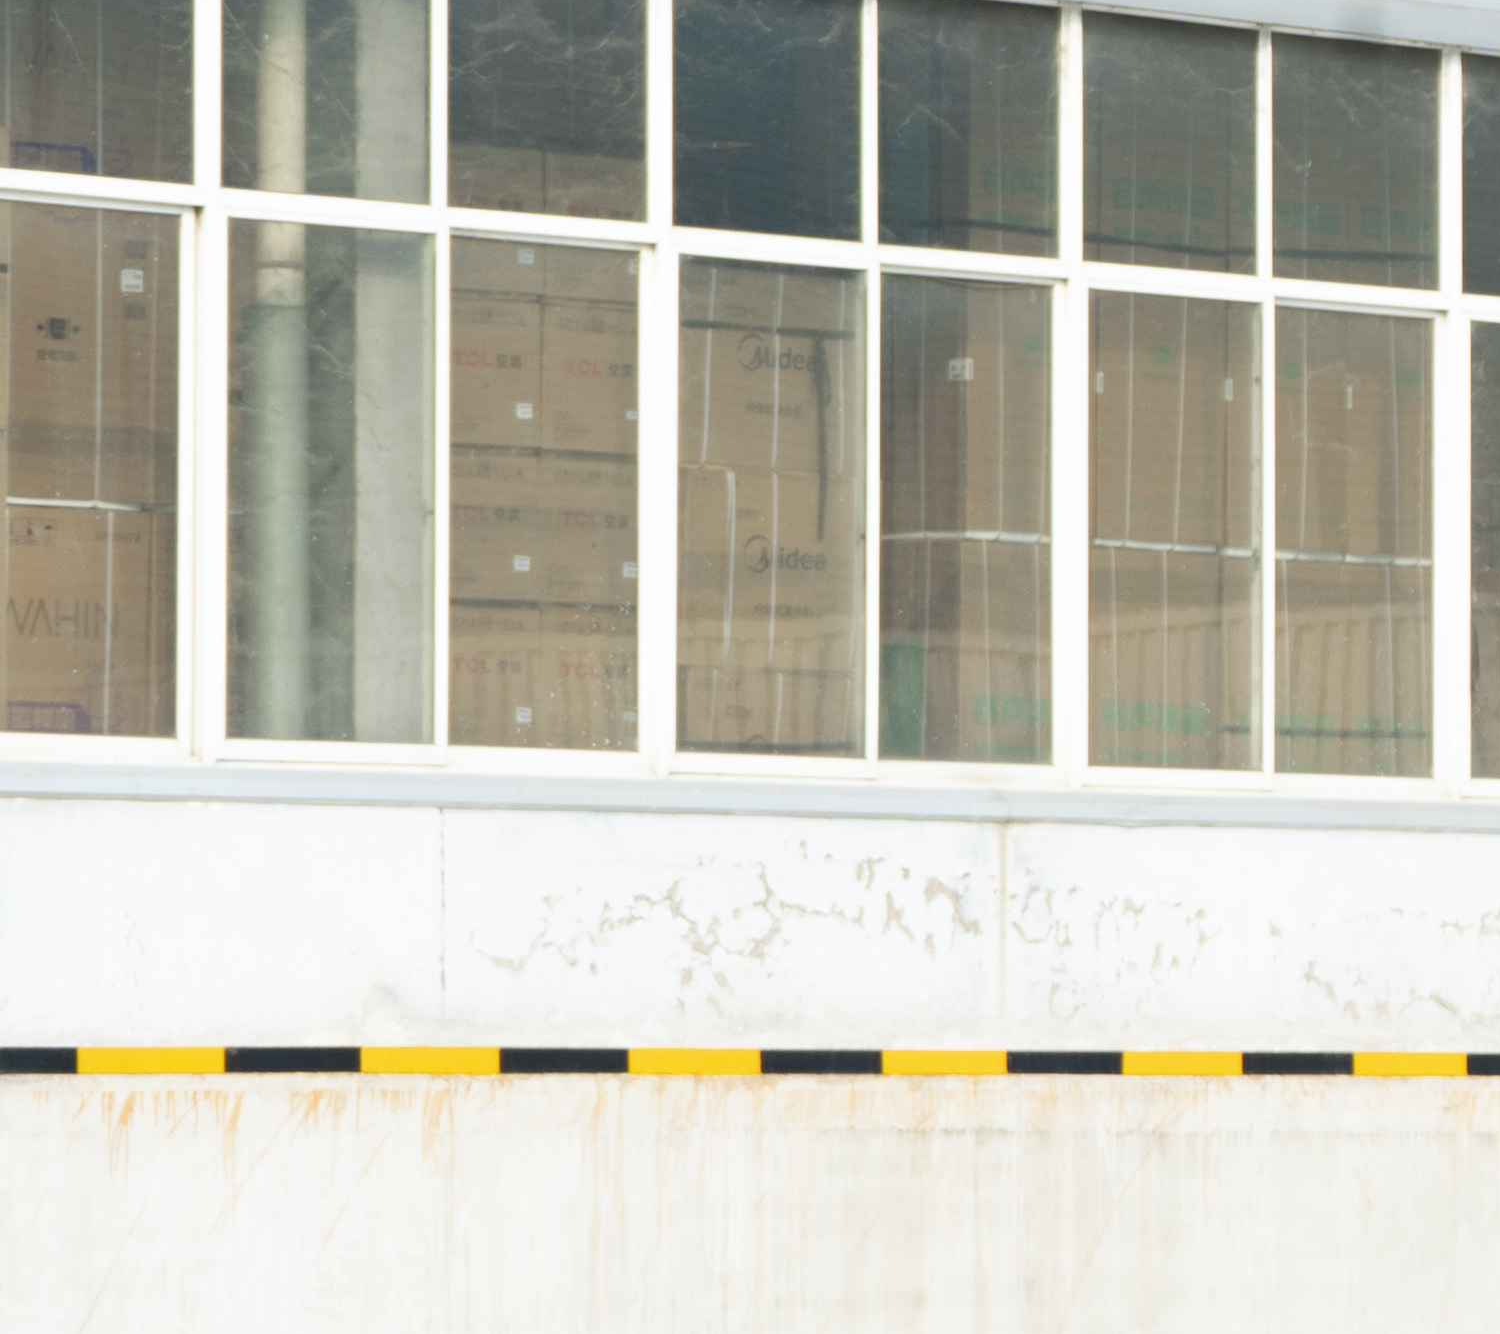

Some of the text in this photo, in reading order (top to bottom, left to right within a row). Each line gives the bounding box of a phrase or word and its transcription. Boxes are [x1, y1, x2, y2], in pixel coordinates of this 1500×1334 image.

[453, 350, 492, 368] TCL
[564, 358, 603, 376] TCL
[561, 510, 600, 528] TCL
